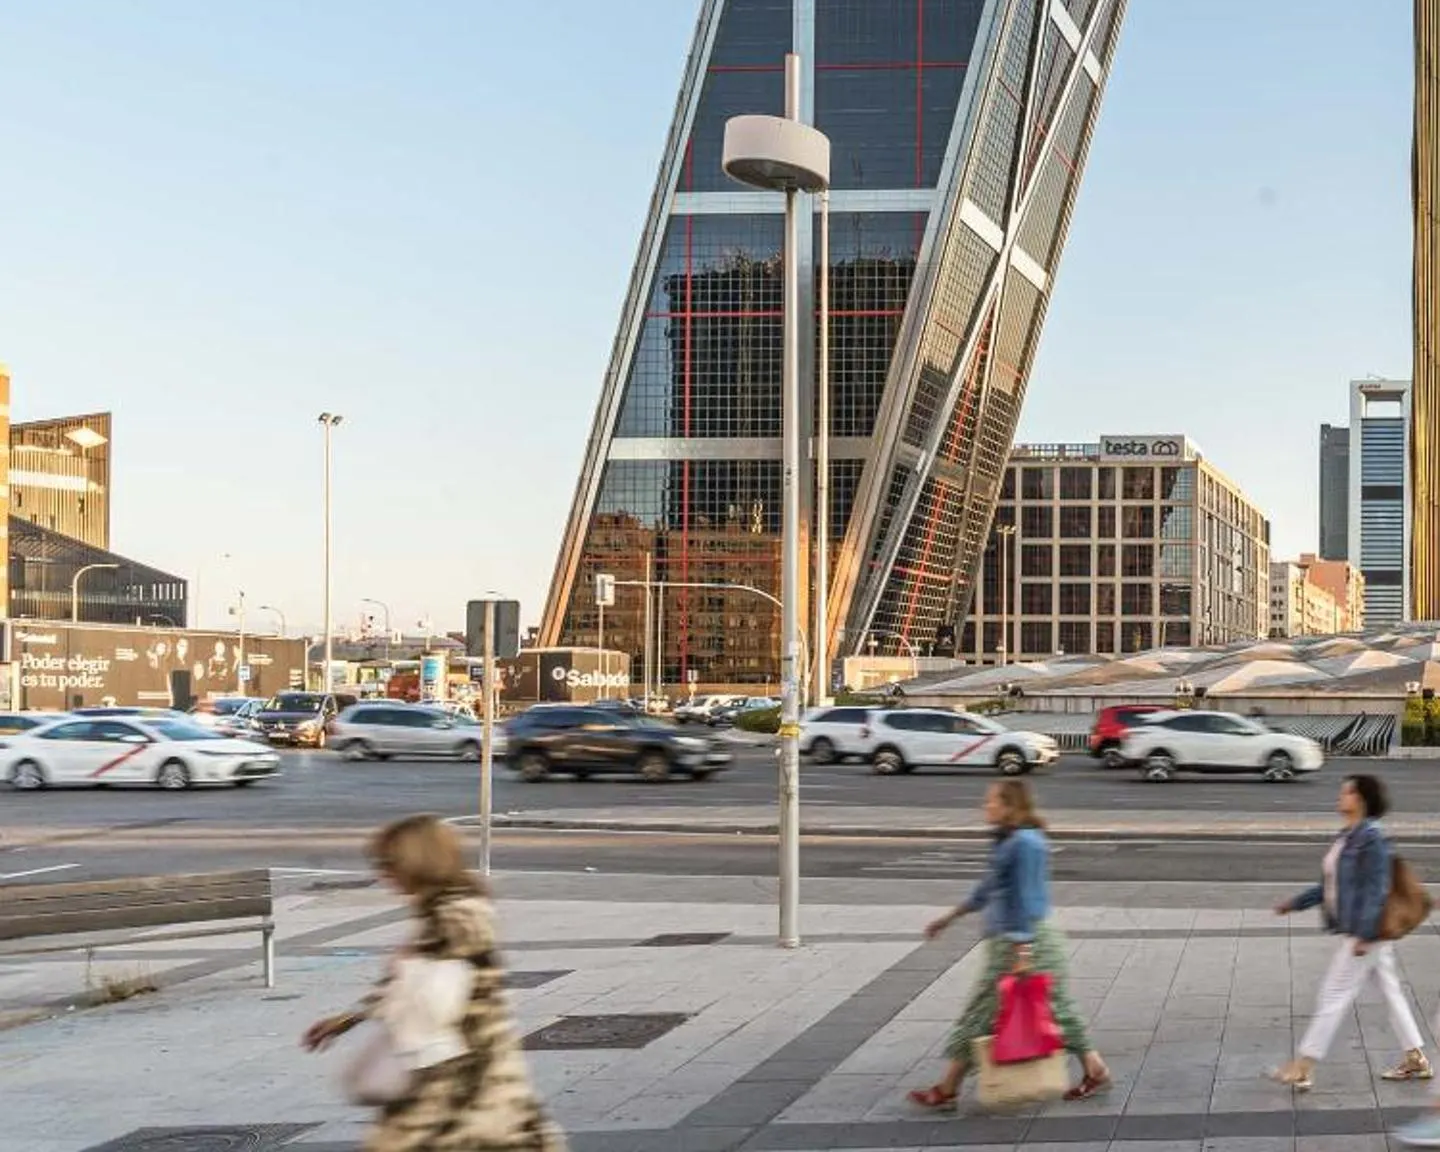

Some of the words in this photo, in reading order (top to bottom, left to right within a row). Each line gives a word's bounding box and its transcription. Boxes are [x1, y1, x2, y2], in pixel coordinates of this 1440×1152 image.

[1105, 440, 1147, 456] testa
[21, 652, 66, 670] Poder
[68, 654, 110, 674] elegir
[21, 675, 38, 686] es
[40, 674, 57, 686] tu
